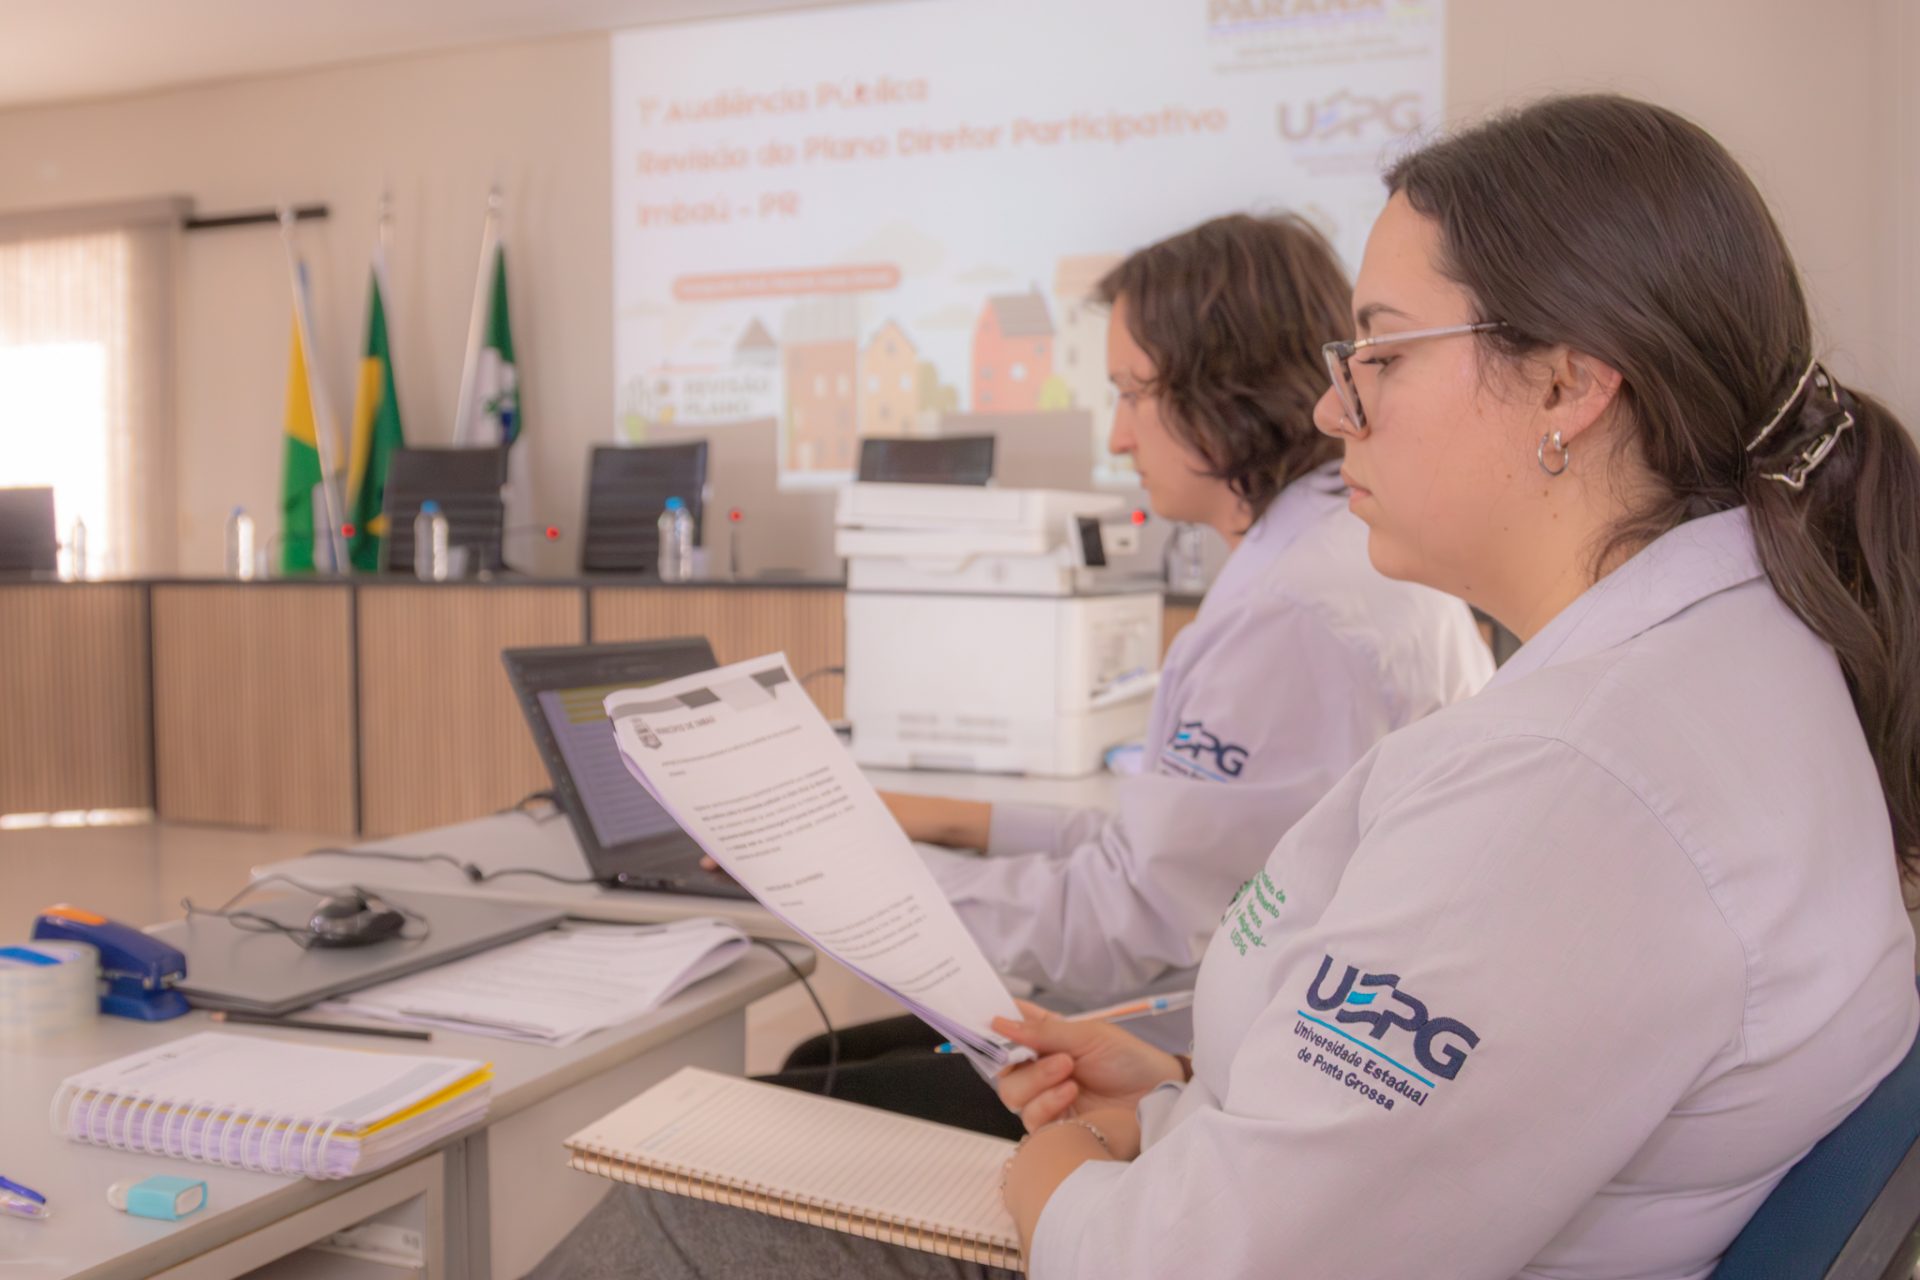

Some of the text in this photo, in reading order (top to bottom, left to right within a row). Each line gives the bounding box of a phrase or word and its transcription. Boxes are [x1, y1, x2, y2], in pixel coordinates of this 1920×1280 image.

[636, 140, 749, 176] Revisão
[804, 132, 889, 162] Plano
[897, 121, 1003, 155] Diretor
[1011, 104, 1229, 149] Participativo
[1306, 954, 1480, 1081] UEPG
[1294, 1020, 1429, 1106] Universidade Estadual
[1297, 1047, 1395, 1111] de Ponta Grossa
